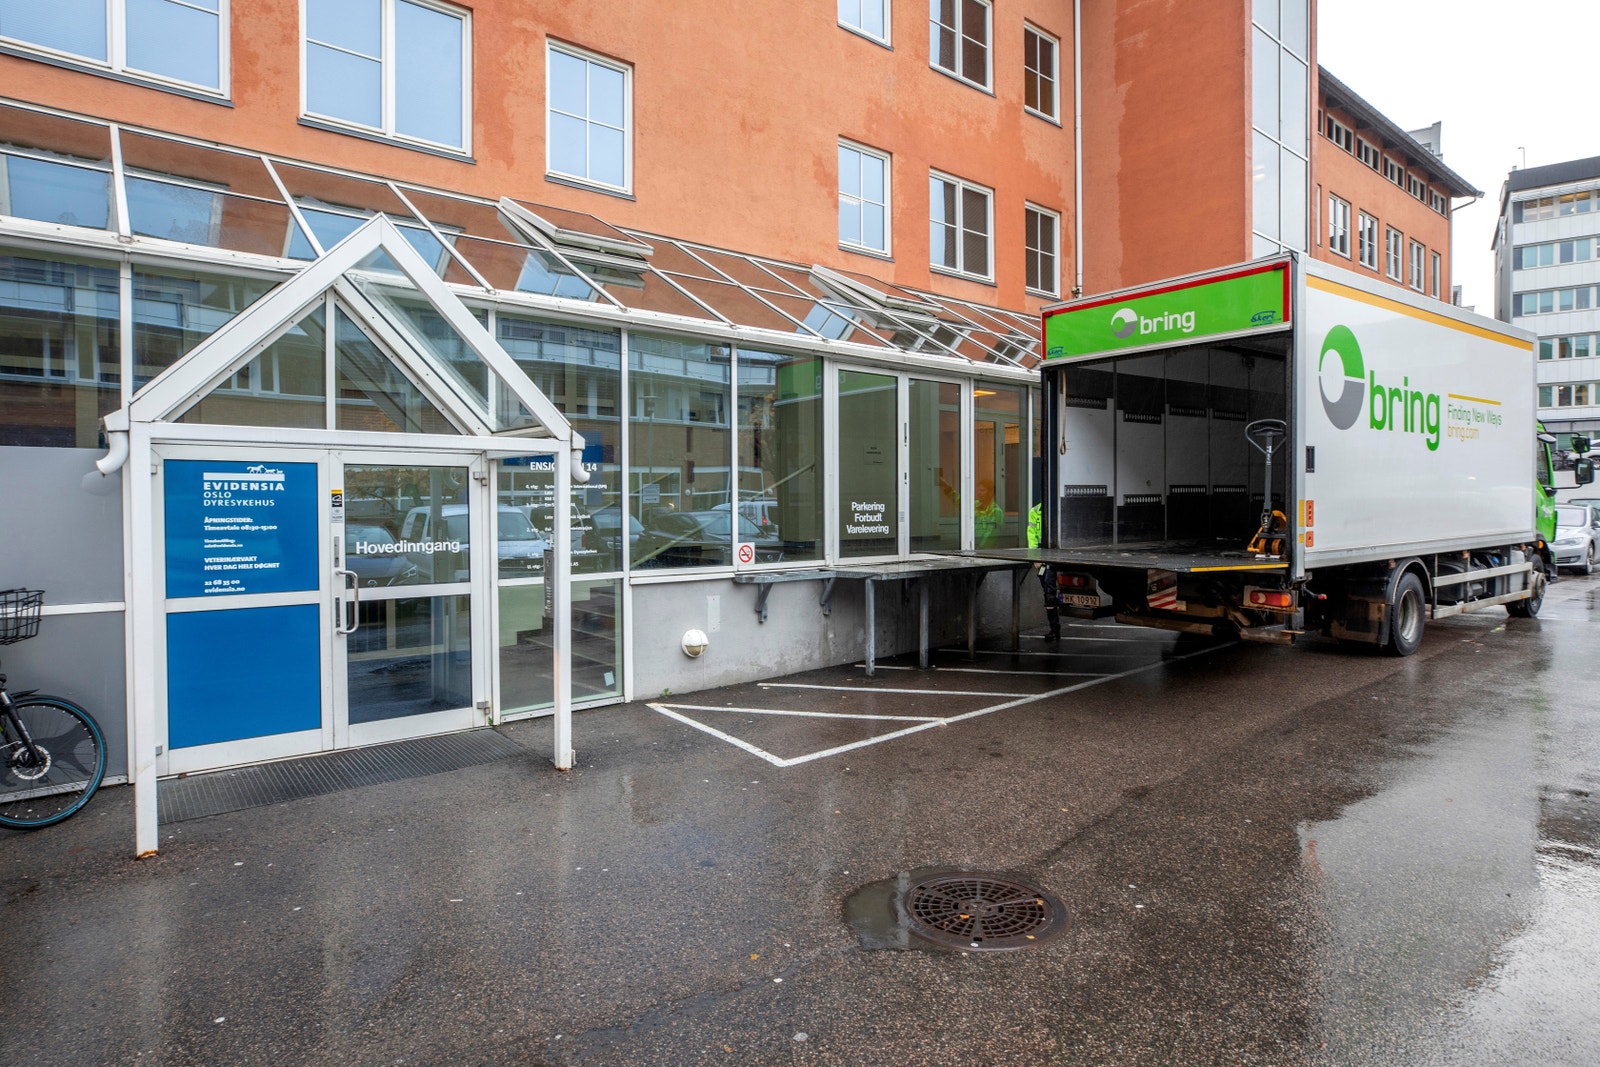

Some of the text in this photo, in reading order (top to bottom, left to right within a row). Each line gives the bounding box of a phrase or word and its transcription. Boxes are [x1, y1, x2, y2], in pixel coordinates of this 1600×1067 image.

[1140, 310, 1195, 335] bring
[1369, 370, 1440, 451] bring
[1447, 403, 1502, 428] Finding New Ways
[1447, 422, 1480, 442] bring.com
[586, 463, 597, 471] 14
[203, 482, 285, 491] EVIDENSIA
[203, 491, 232, 499] OSLO
[203, 499, 275, 507] DYRESYKEHUS
[851, 502, 885, 512] Parkering
[854, 513, 883, 522] Forbudt
[846, 524, 890, 535] Varelevering
[355, 540, 460, 555] Hovedinngang
[1064, 594, 1074, 603] HK
